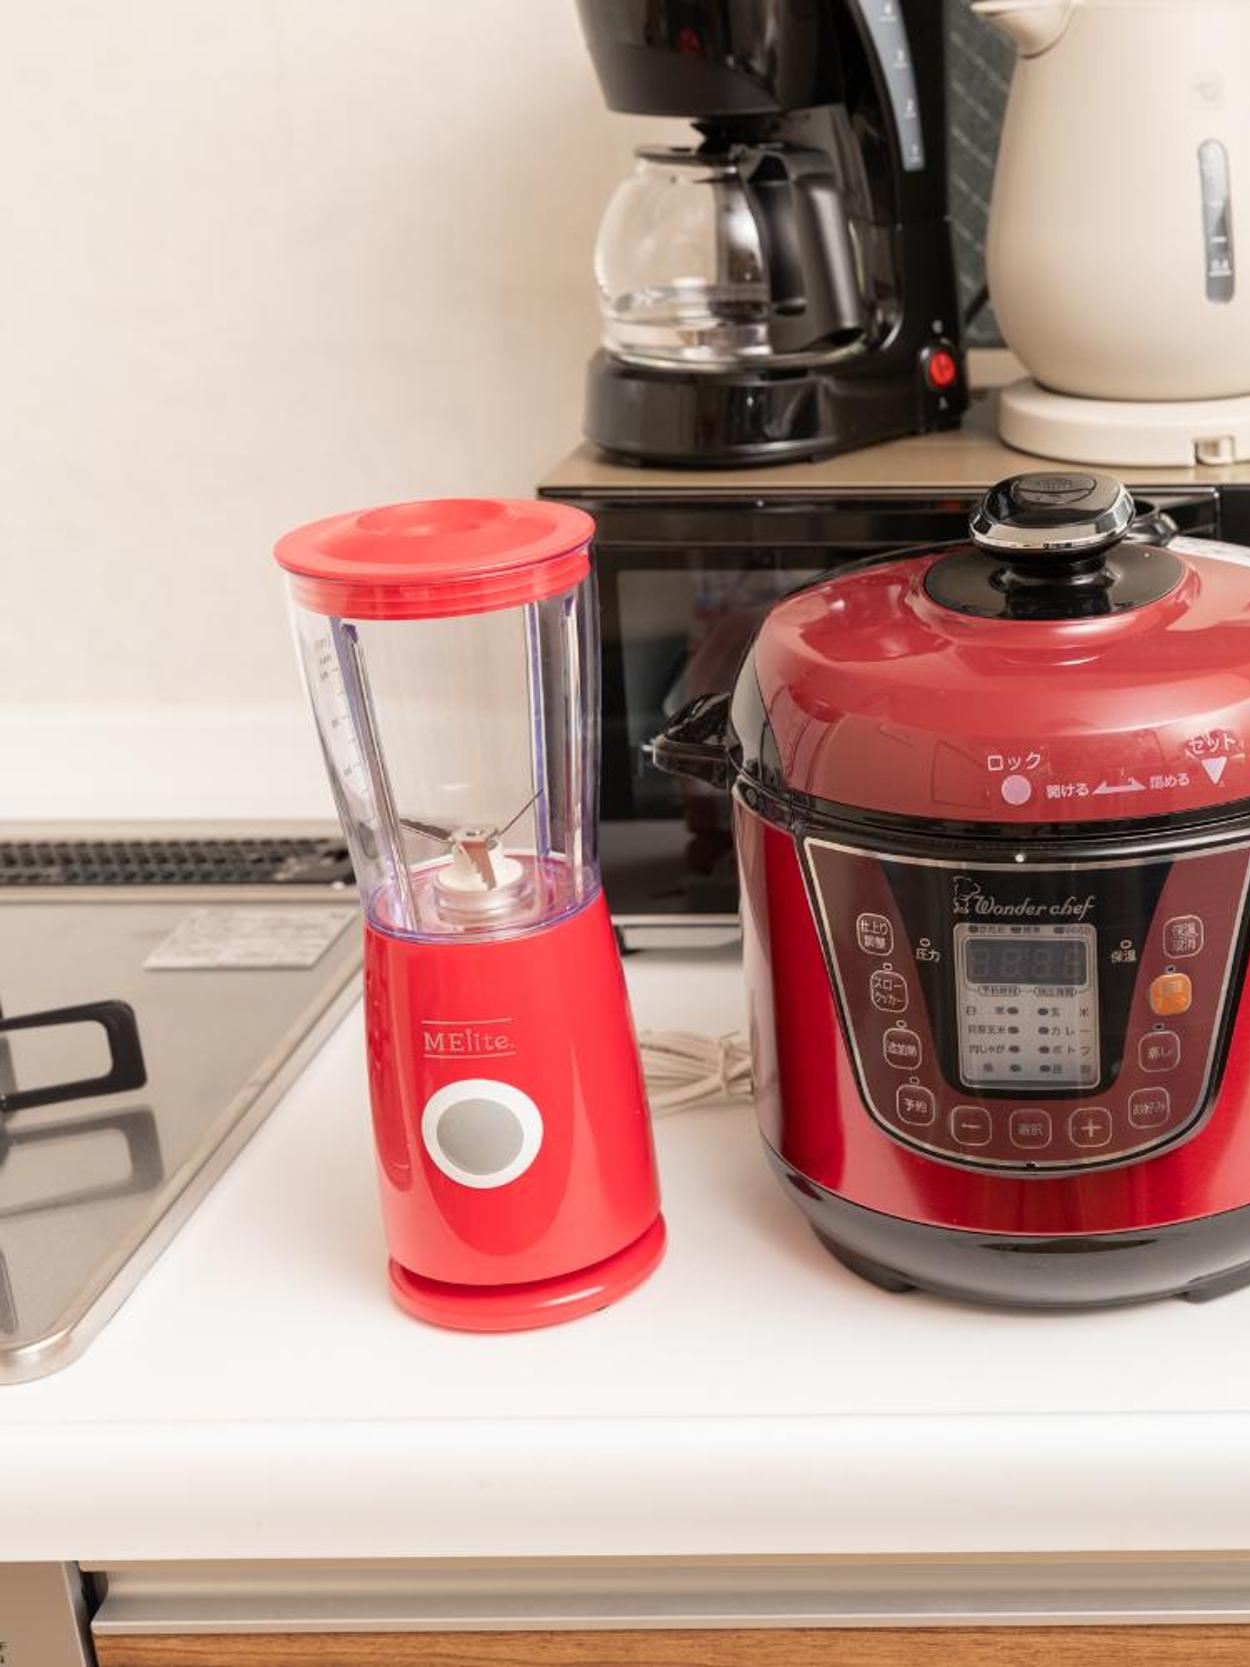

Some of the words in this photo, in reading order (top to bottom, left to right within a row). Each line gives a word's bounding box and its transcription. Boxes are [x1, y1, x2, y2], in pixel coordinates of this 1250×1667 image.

[1187, 732, 1236, 754] セット
[988, 752, 1041, 771] ロック
[974, 895, 1046, 916] Wonder
[1050, 896, 1096, 921] chef
[916, 947, 941, 963] 圧力
